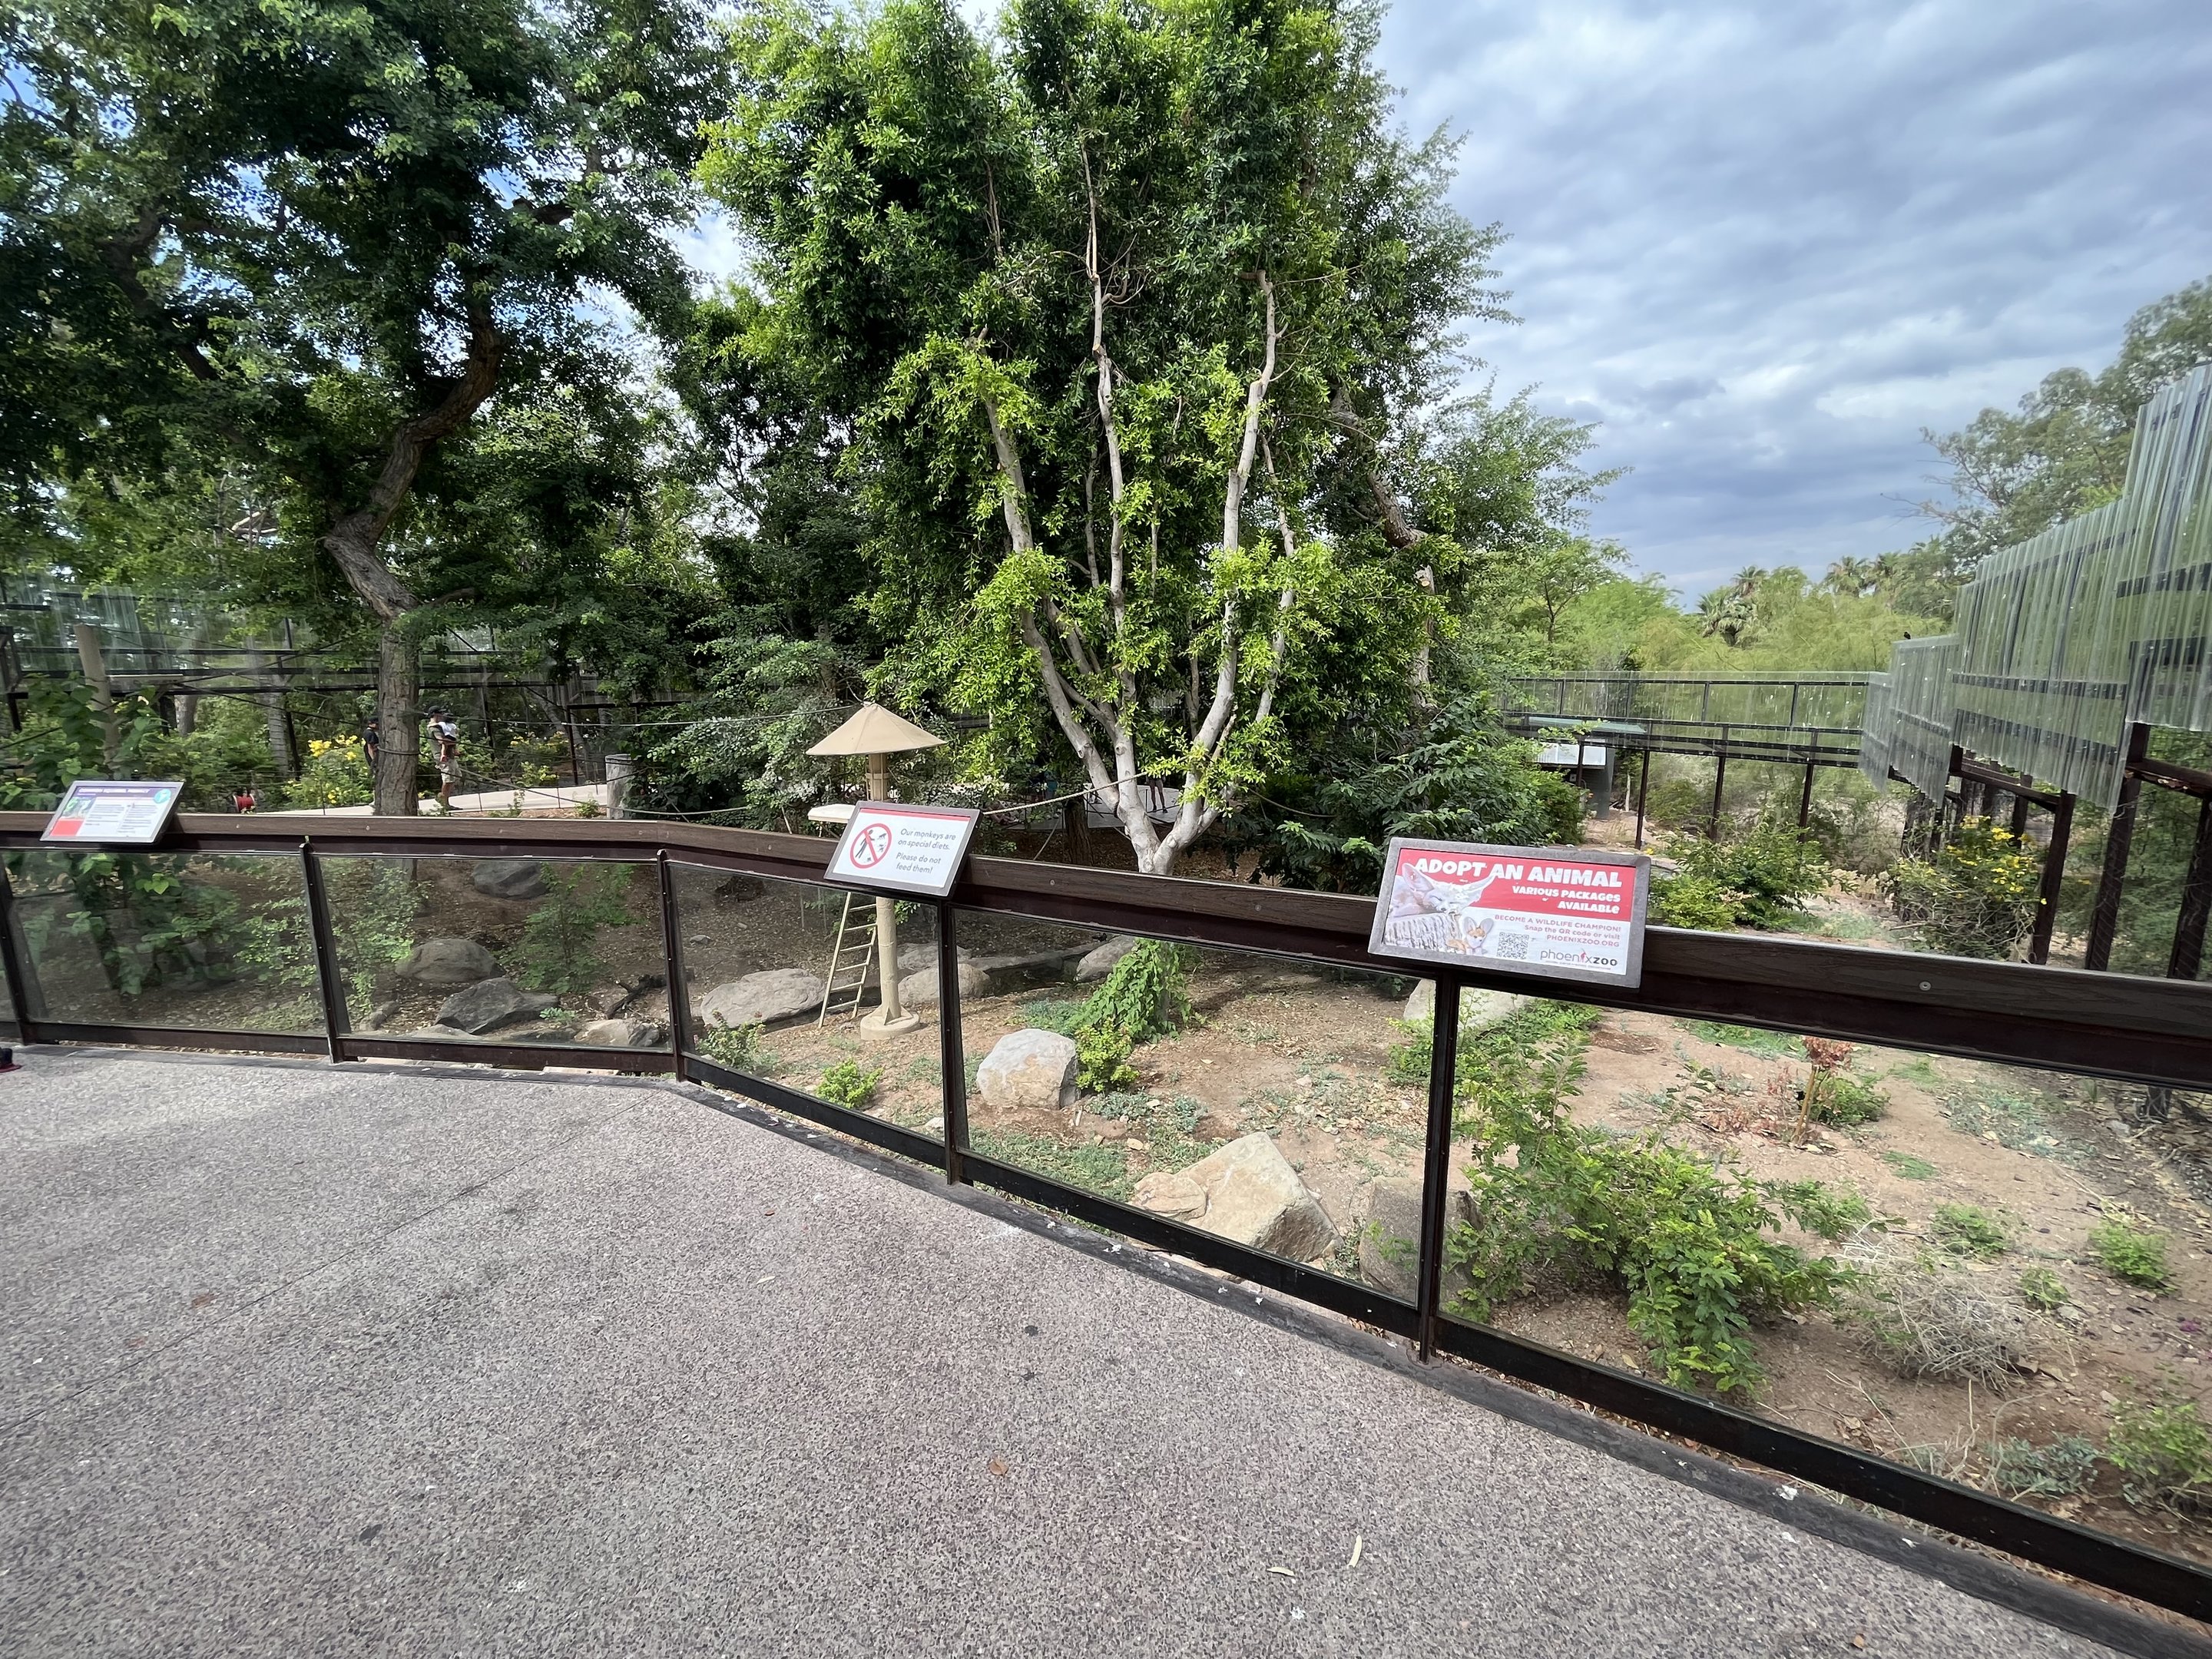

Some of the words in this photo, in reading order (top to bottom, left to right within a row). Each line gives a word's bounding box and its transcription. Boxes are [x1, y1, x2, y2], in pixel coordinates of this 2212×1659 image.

[914, 830, 944, 840] monkeys
[932, 842, 950, 850] diets.
[896, 852, 918, 862] Please
[896, 863, 912, 871] feed
[912, 865, 933, 874] them!
[1414, 858, 1487, 877] ADOPT
[1490, 863, 1523, 880] AN
[1527, 866, 1622, 888] ANIMAL
[1512, 886, 1559, 897] VARIOUS
[1495, 914, 1526, 923] BECOME
[1535, 919, 1573, 928] WILDLIFE
[1575, 922, 1621, 932] CHAMPION!
[1546, 935, 1620, 947] PHOENIXZOO.ORG
